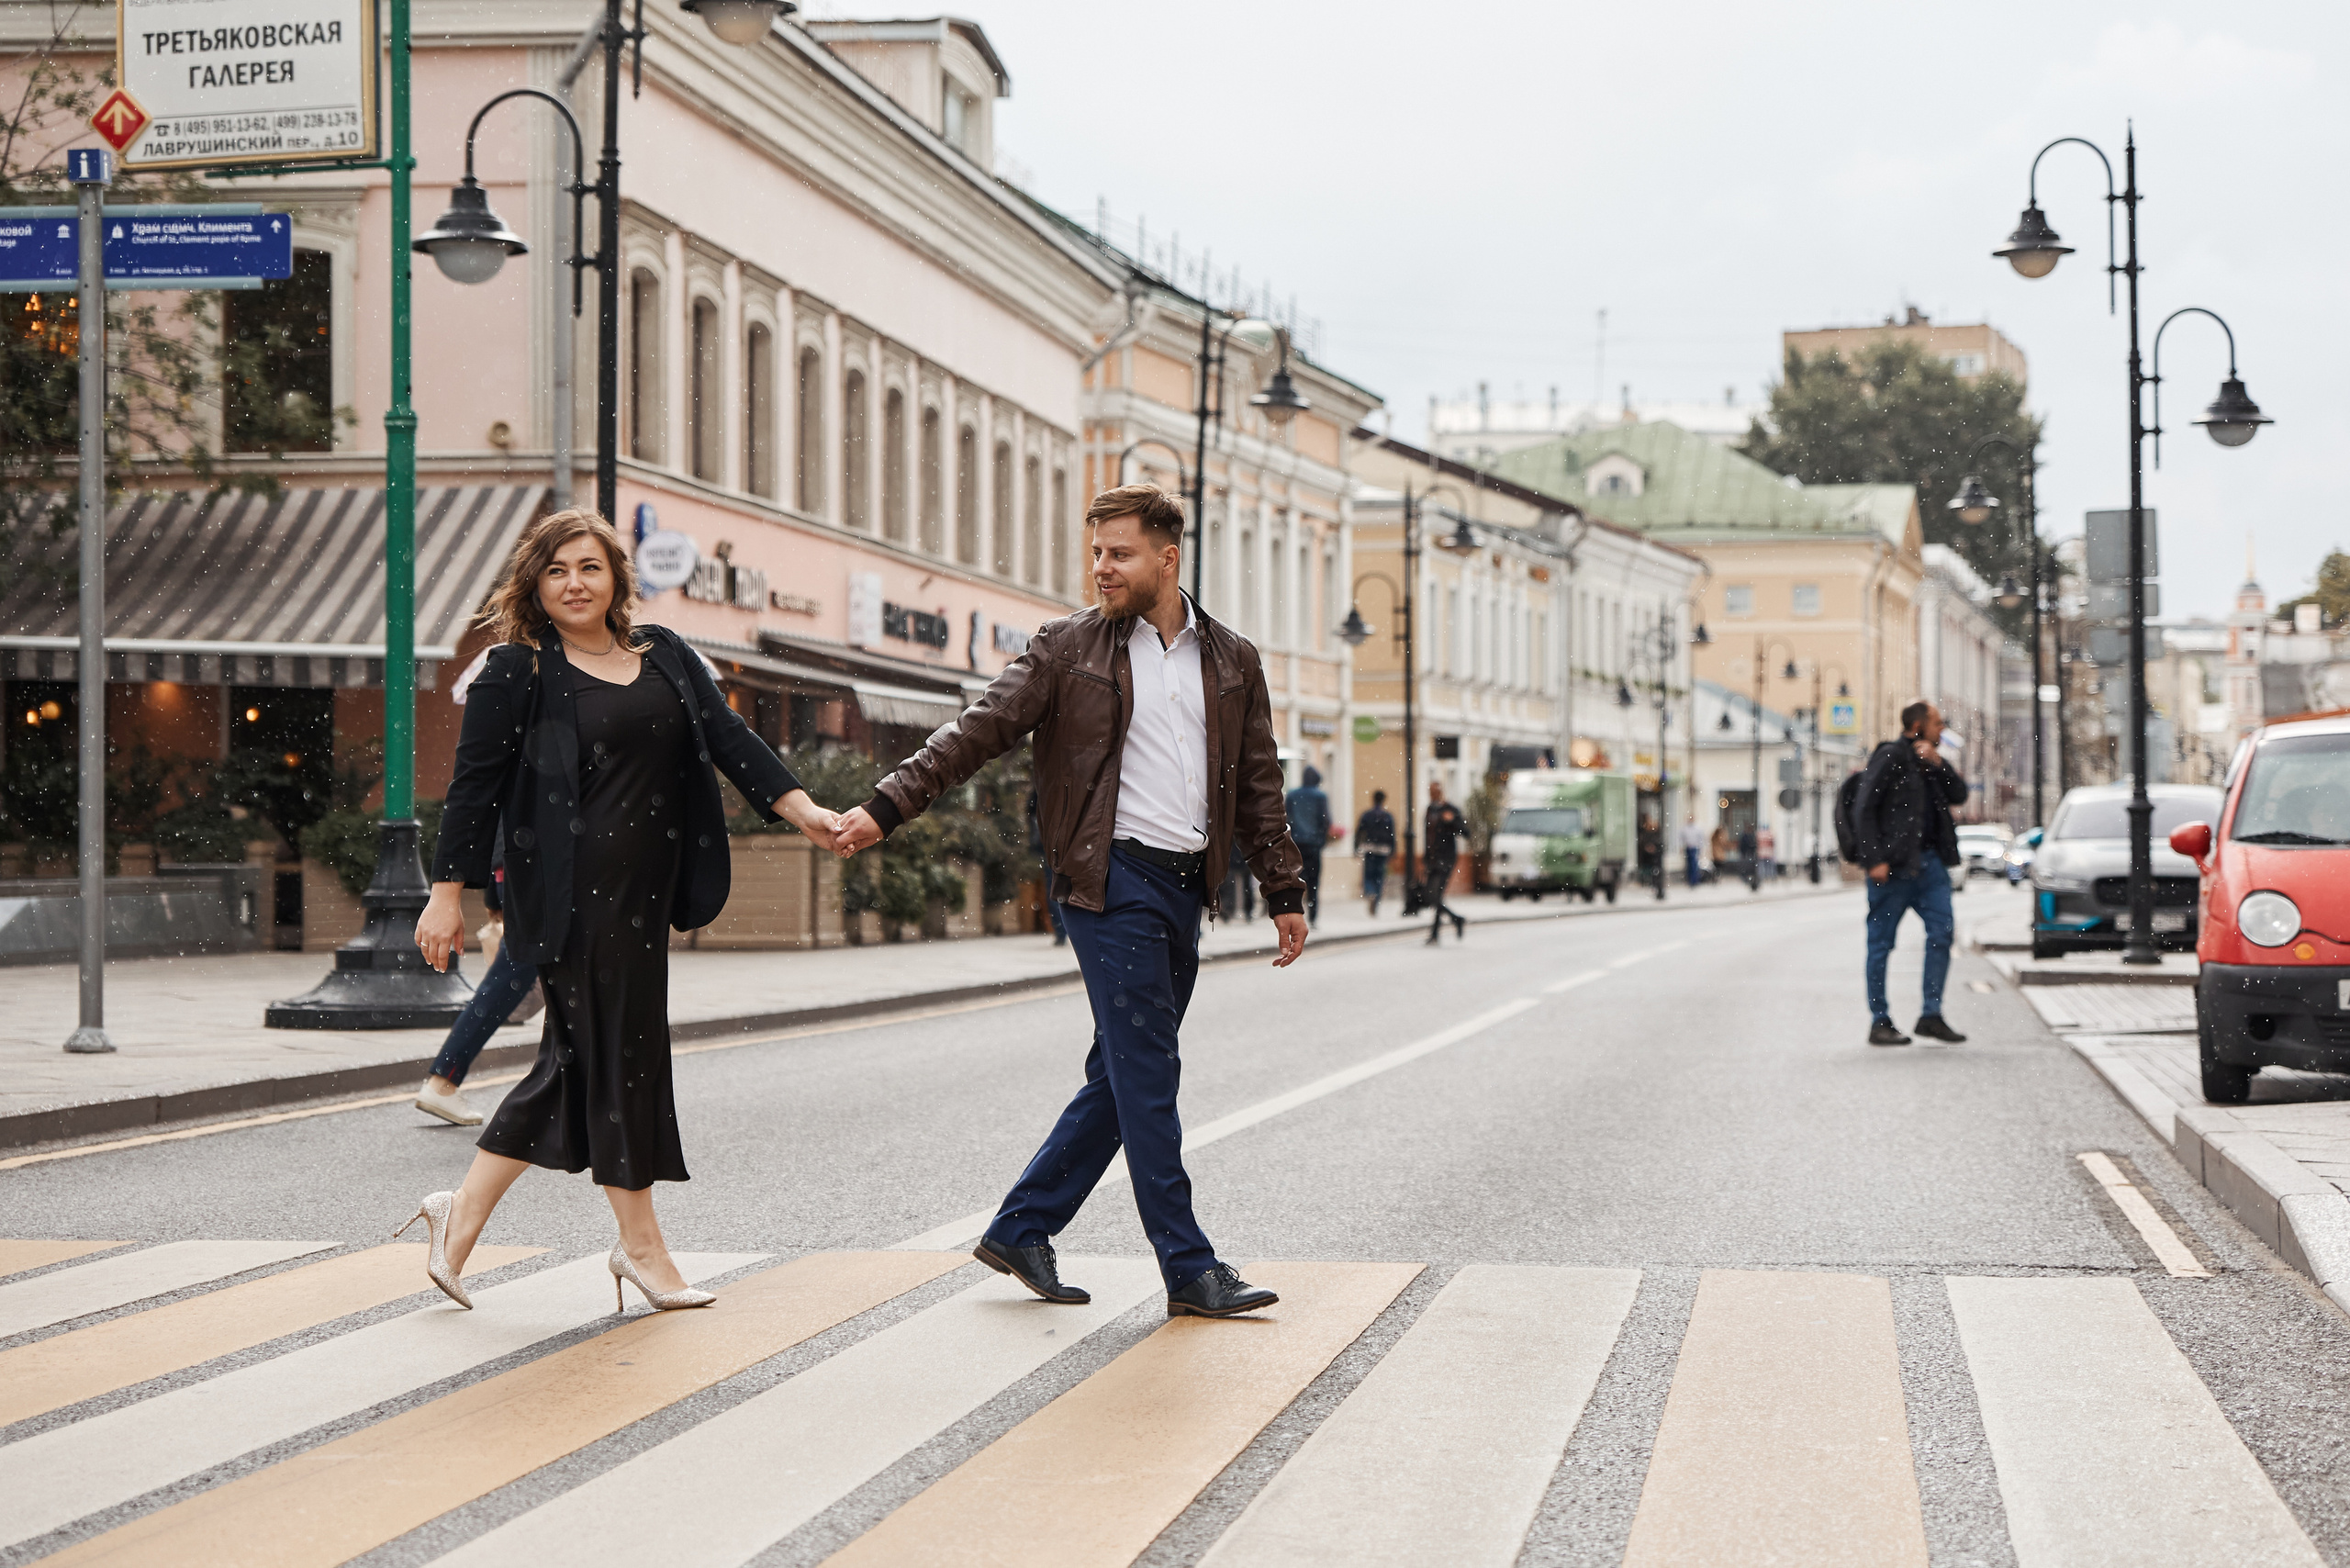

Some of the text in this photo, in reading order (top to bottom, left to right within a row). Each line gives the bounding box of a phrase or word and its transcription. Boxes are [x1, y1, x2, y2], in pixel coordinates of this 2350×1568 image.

[142, 20, 341, 55] ТРЕТЬЯКОВСКАЯ
[189, 60, 295, 89] ГАЛЕРЕЯ
[184, 118, 210, 137] (495)
[143, 129, 282, 157] ЛАВРУШИНСКИЙ
[131, 222, 161, 235] Храм
[198, 221, 252, 233] Климента
